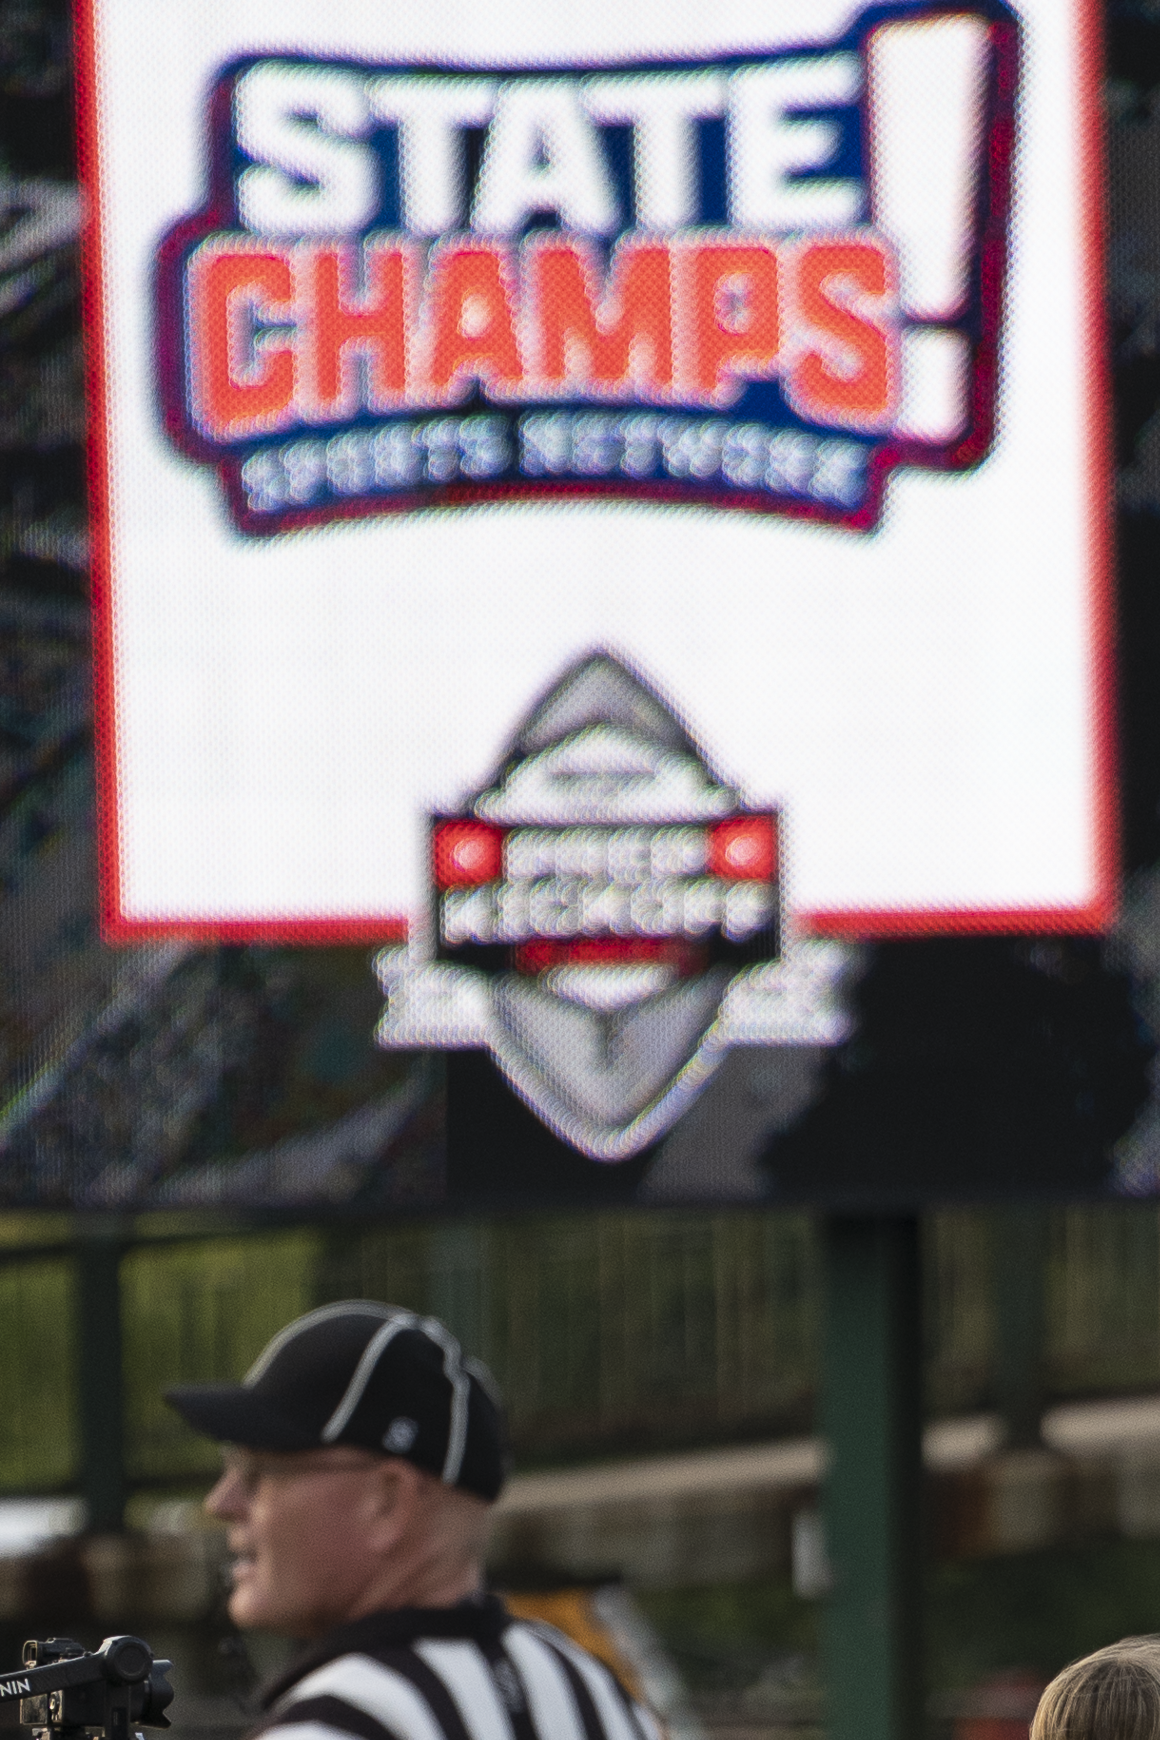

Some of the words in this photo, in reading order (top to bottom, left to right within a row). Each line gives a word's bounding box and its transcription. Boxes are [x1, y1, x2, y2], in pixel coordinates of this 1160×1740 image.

[235, 54, 863, 233] STATE
[188, 232, 898, 440] CHAMPS
[241, 412, 507, 512] SPORTS
[518, 411, 871, 508] NETWORK
